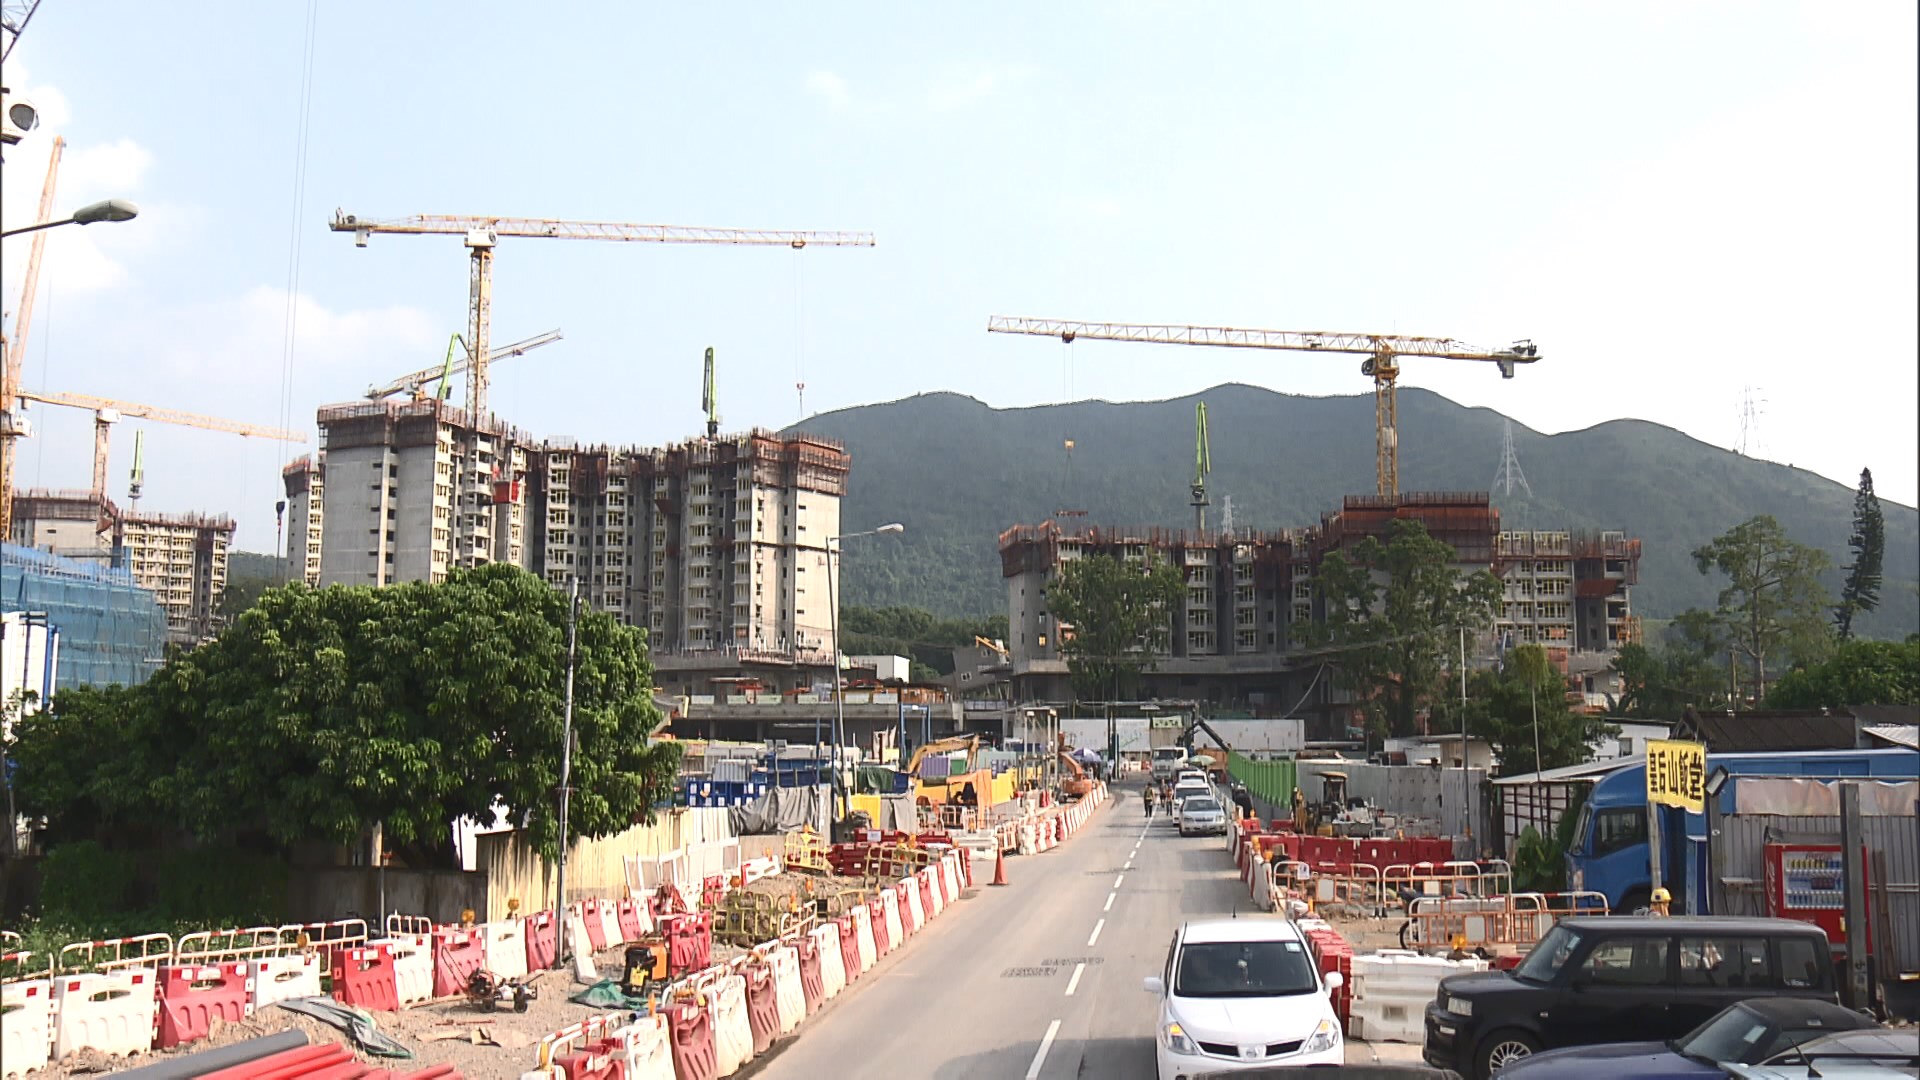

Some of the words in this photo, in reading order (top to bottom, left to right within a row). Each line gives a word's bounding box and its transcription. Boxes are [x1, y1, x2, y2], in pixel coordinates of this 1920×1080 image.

[1649, 748, 1702, 800] 皇后山飯堂
